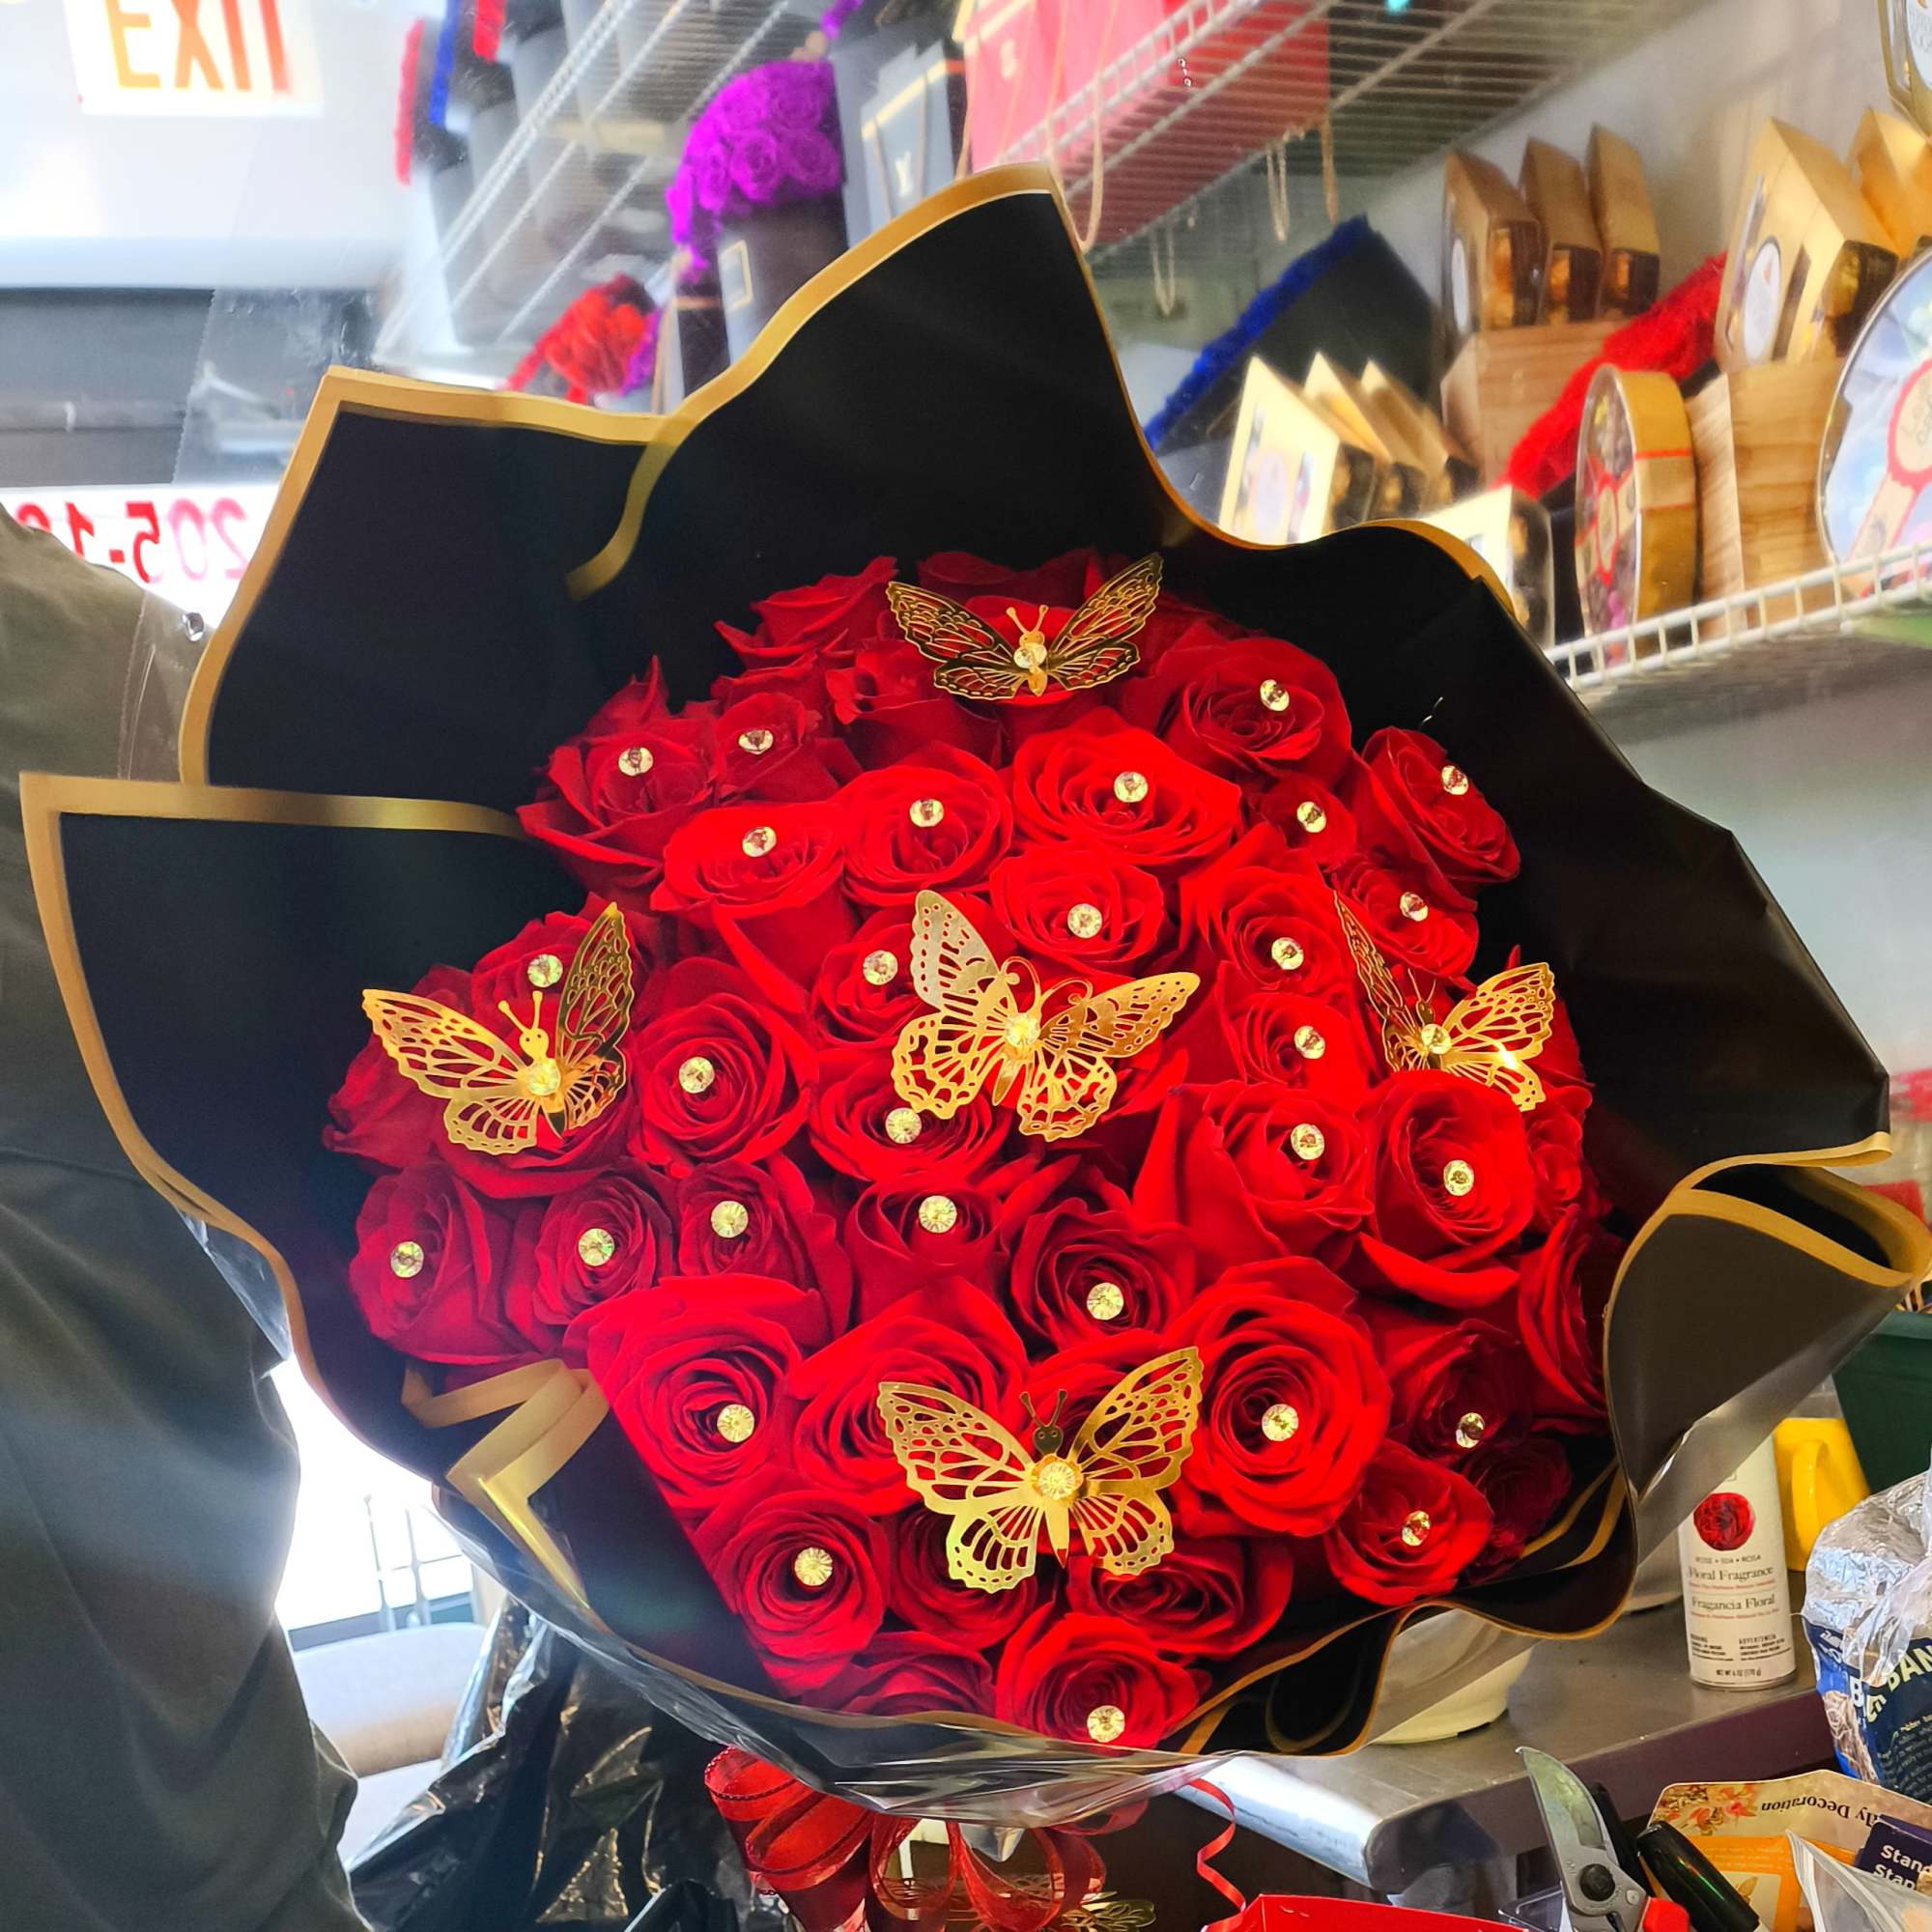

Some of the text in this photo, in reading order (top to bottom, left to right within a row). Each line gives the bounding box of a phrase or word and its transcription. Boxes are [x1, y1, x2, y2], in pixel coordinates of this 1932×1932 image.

[1719, 1566, 1774, 1582] Fragrance
[1746, 1593, 1776, 1608] Floral
[1761, 1795, 1852, 1820] Decoration
